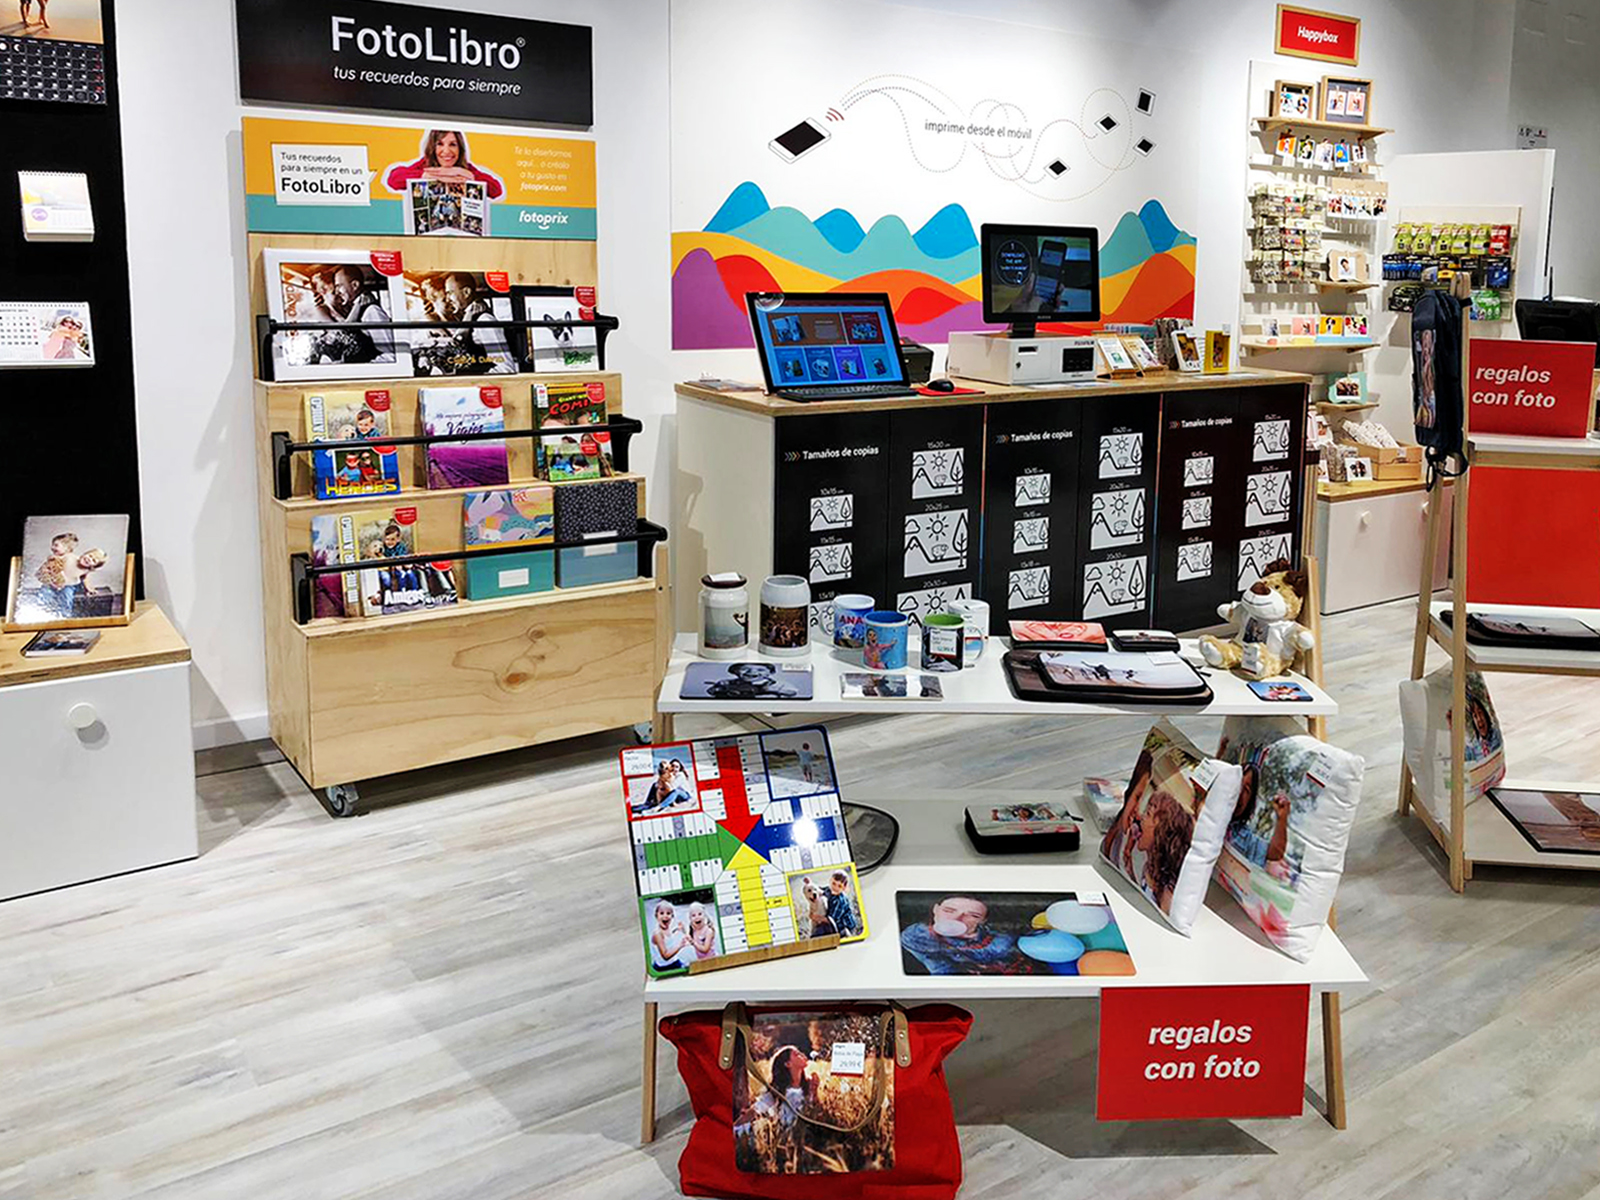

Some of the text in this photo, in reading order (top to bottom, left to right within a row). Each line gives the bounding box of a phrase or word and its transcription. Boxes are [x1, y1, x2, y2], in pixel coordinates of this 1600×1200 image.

[1297, 26, 1340, 43] Happybox
[333, 66, 522, 96] tus recuerdos para siempre
[924, 118, 1032, 139] imprime desde el móvil
[281, 152, 342, 163] Tus recuerdos
[281, 164, 301, 173] para
[303, 164, 338, 174] siempre
[519, 182, 567, 192] fotoprix.com
[519, 210, 569, 226] fotoprix
[1475, 365, 1551, 385] regalos
[1472, 389, 1556, 408] con foto
[549, 399, 595, 415] COMI
[1011, 429, 1073, 442] Tamaños de copias
[802, 445, 879, 460] Tamaños de copias
[840, 614, 865, 625] ANA
[1148, 1019, 1253, 1050] regalos
[1144, 1055, 1260, 1080] con foto
